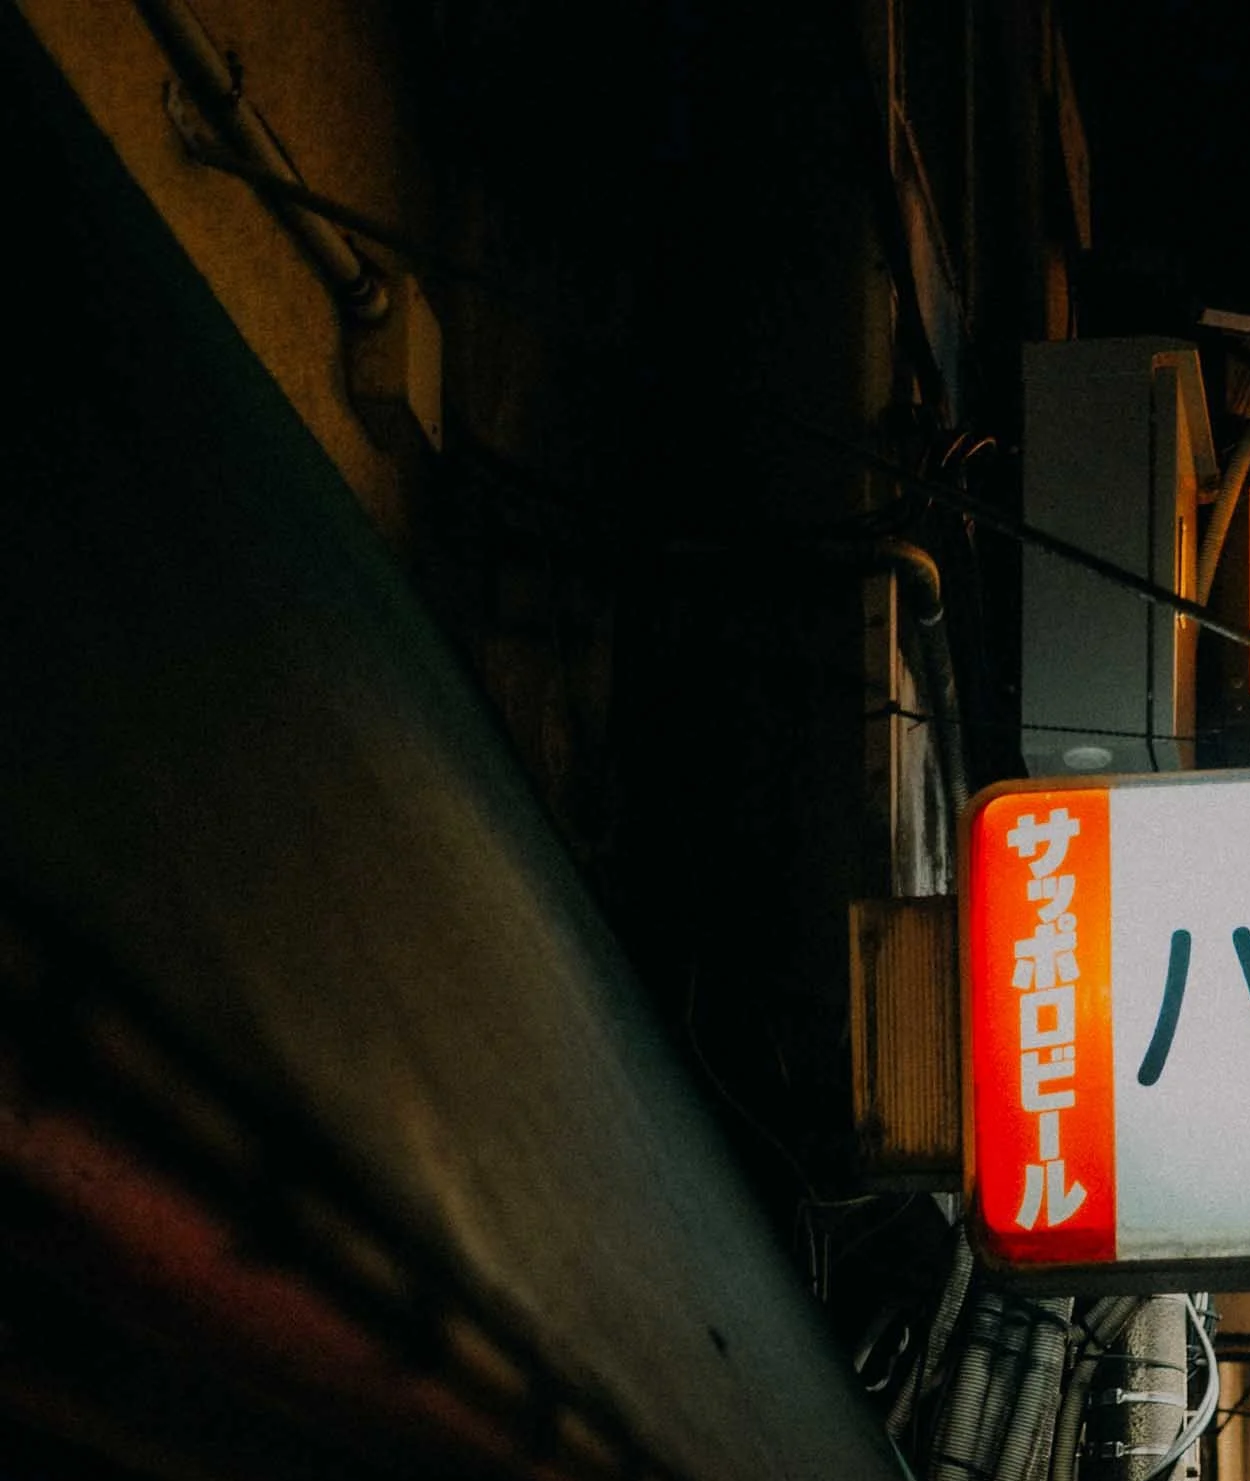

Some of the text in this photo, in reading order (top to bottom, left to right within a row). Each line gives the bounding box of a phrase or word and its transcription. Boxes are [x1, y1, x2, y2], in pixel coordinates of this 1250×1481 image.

[1006, 807, 1087, 1231] サッポロビール
